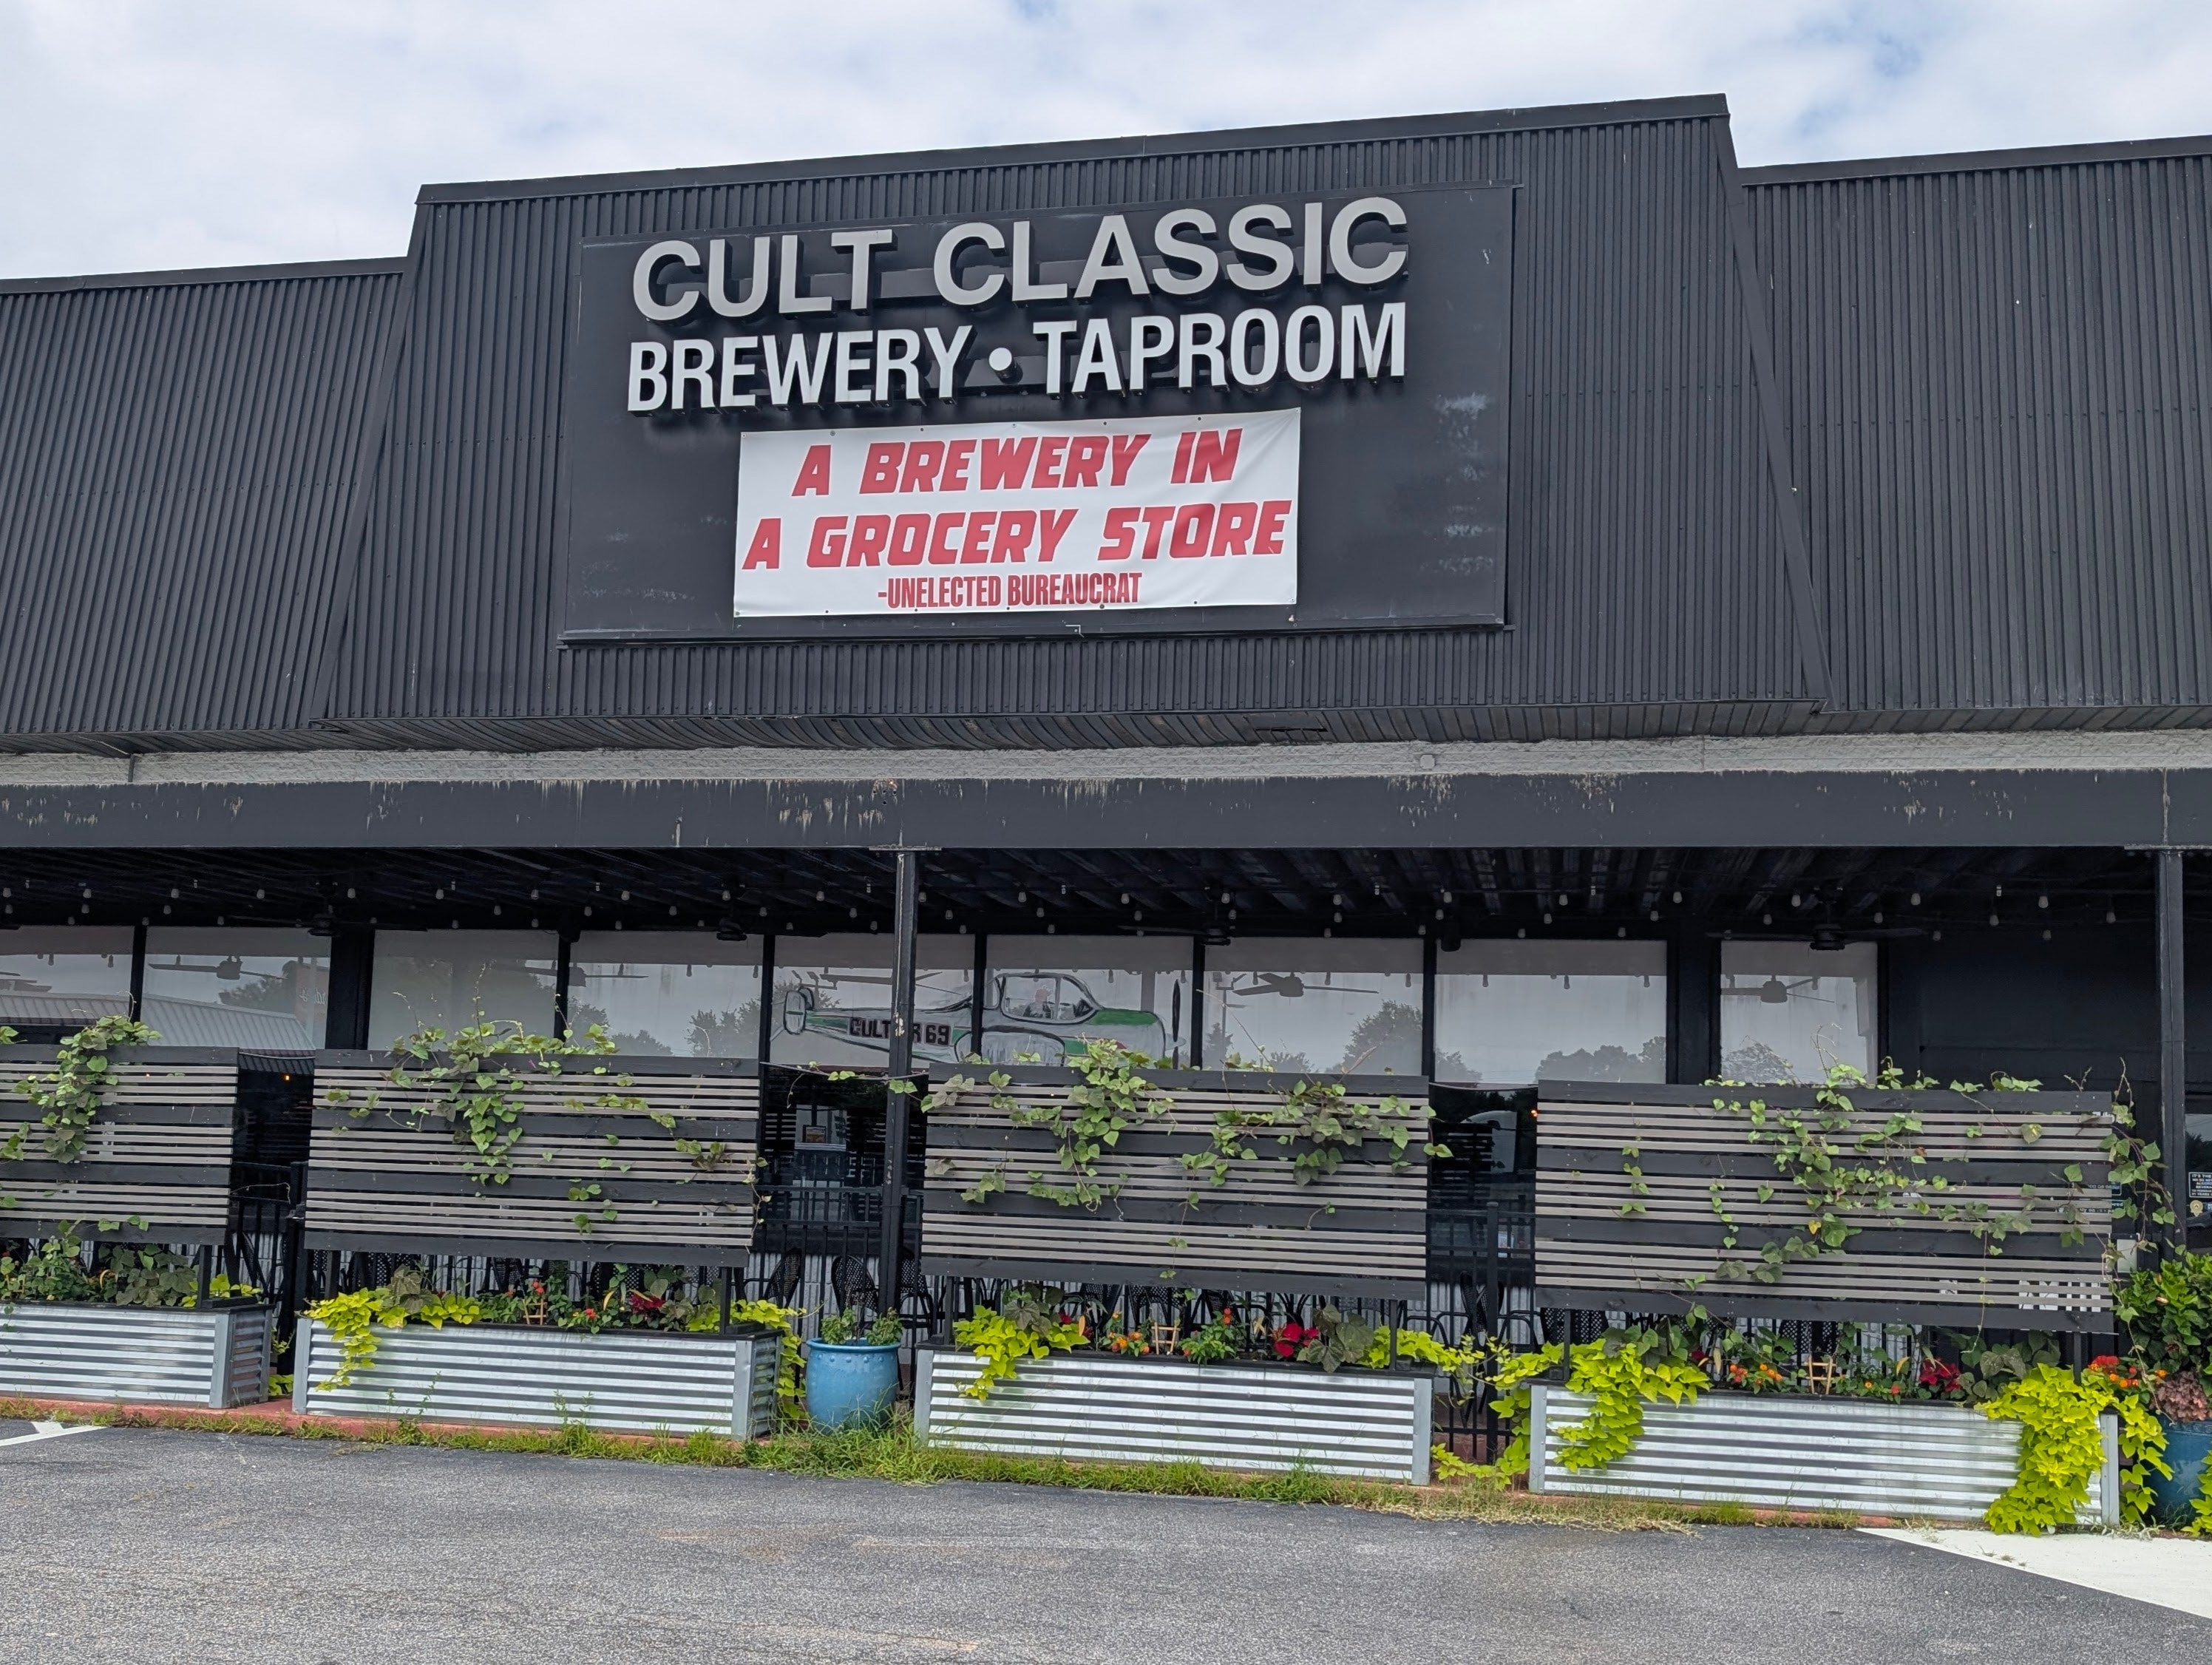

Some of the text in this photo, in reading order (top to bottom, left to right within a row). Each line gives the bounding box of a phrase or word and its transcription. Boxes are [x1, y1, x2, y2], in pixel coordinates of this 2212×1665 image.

[634, 197, 1407, 321] CULT CLASSIC
[628, 302, 1406, 411] BREWERY TAPROOM
[791, 428, 1243, 497] A BREWERY IN
[742, 500, 1292, 570] A GROCERY STORE
[878, 572, 1143, 608] -UNELECTED BUREAUCRAT
[849, 1017, 951, 1045] CULTR 69
